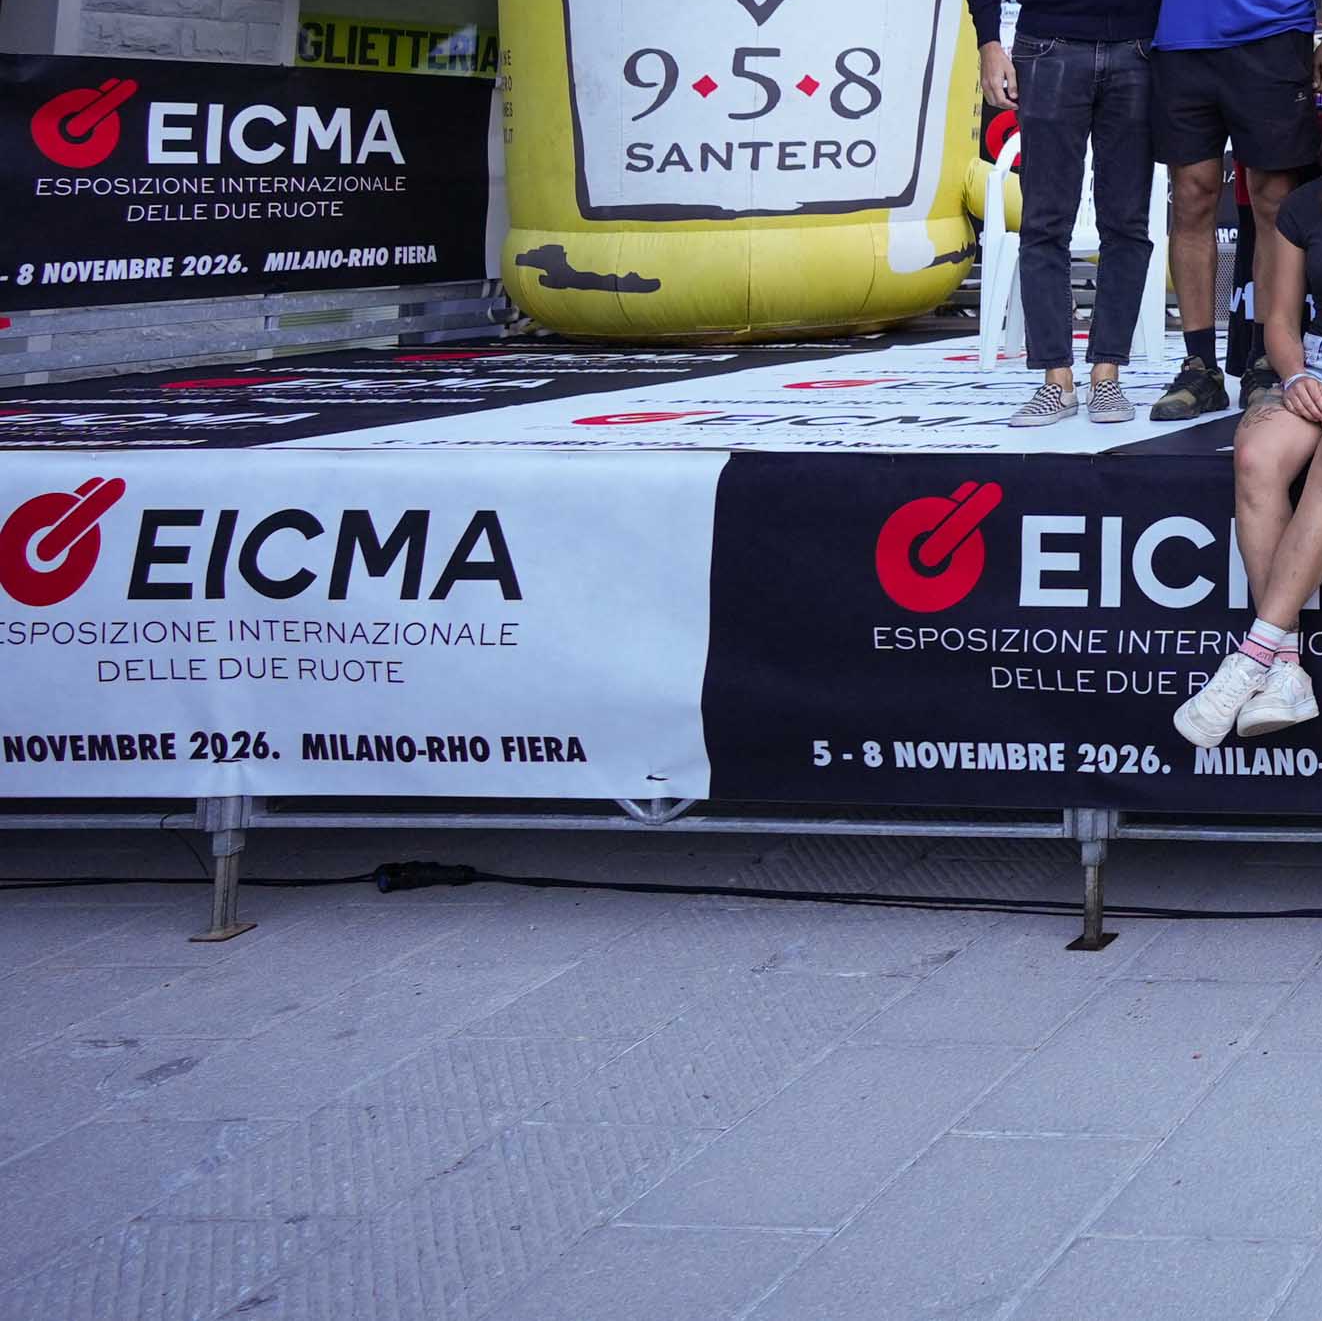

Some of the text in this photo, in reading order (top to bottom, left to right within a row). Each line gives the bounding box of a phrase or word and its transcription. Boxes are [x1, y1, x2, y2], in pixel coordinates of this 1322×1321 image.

[147, 101, 406, 165] EICMA
[624, 139, 877, 173] SANTERO
[36, 176, 407, 197] ESPOSIZIONE INTERNAZIONALE
[127, 200, 344, 222] DELLE DUE RUOTE
[16, 245, 438, 286] 8 NOVEMBRE 2026. MILANO-RHO FIERA
[127, 509, 522, 601] EICMA
[228, 619, 519, 647] INTERNAZIONALE
[873, 627, 1108, 654] ESPOSIZIONE
[97, 657, 405, 683] DELLE DUE RUOTE
[991, 667, 1095, 694] DELLE
[1107, 670, 1179, 696] DUE
[3, 730, 587, 763] NOVEMBRE 2026. MILANO-RHO FIERA
[813, 740, 832, 768] 5
[863, 741, 882, 769] 8
[893, 741, 1066, 773] NOVEMBRE
[1078, 743, 1172, 776] 2026.
